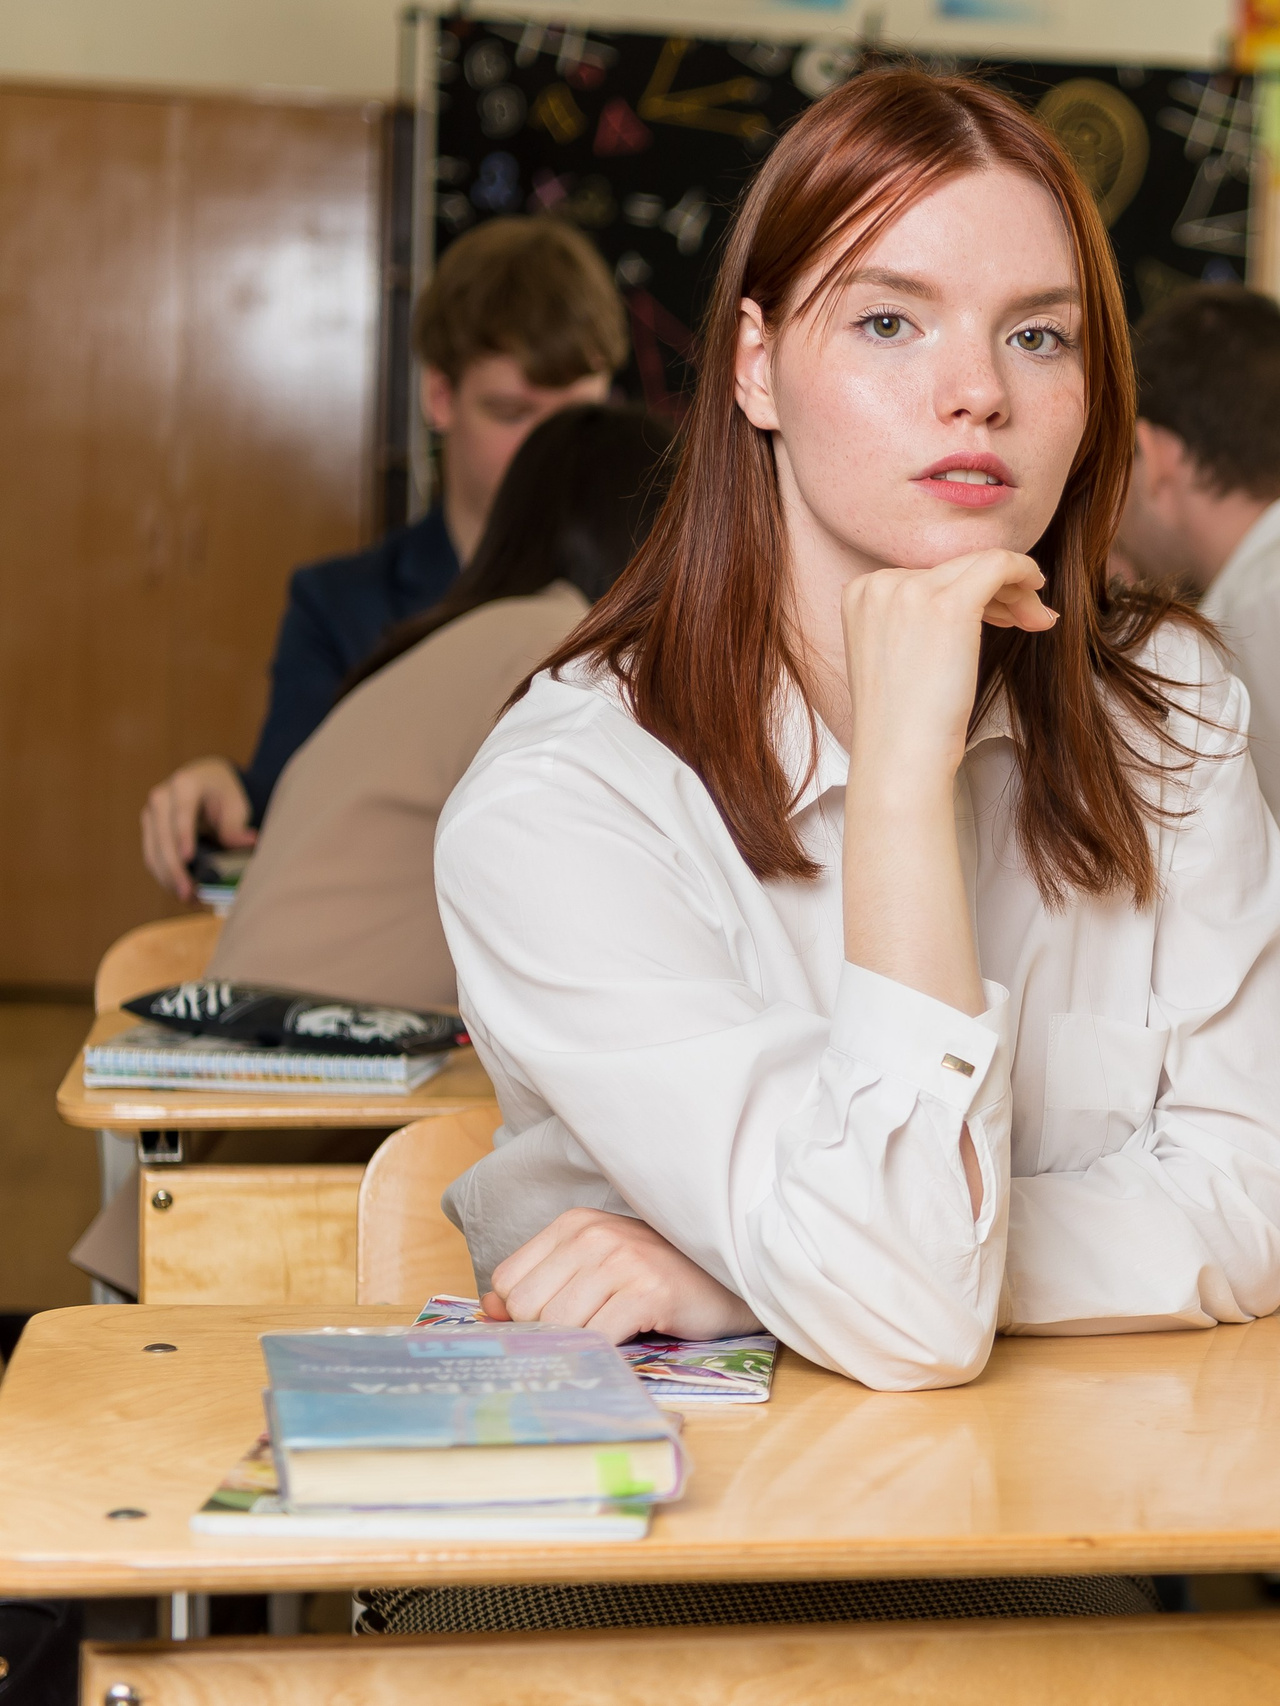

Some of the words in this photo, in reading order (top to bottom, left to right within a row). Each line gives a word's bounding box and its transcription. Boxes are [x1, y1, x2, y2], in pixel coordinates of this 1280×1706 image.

[415, 1340, 460, 1352] 11
[438, 1356, 564, 1367] АНАЛИЗА
[435, 1371, 542, 1381] НАЧАЛА
[348, 1377, 602, 1394] АЛГЕБРА
